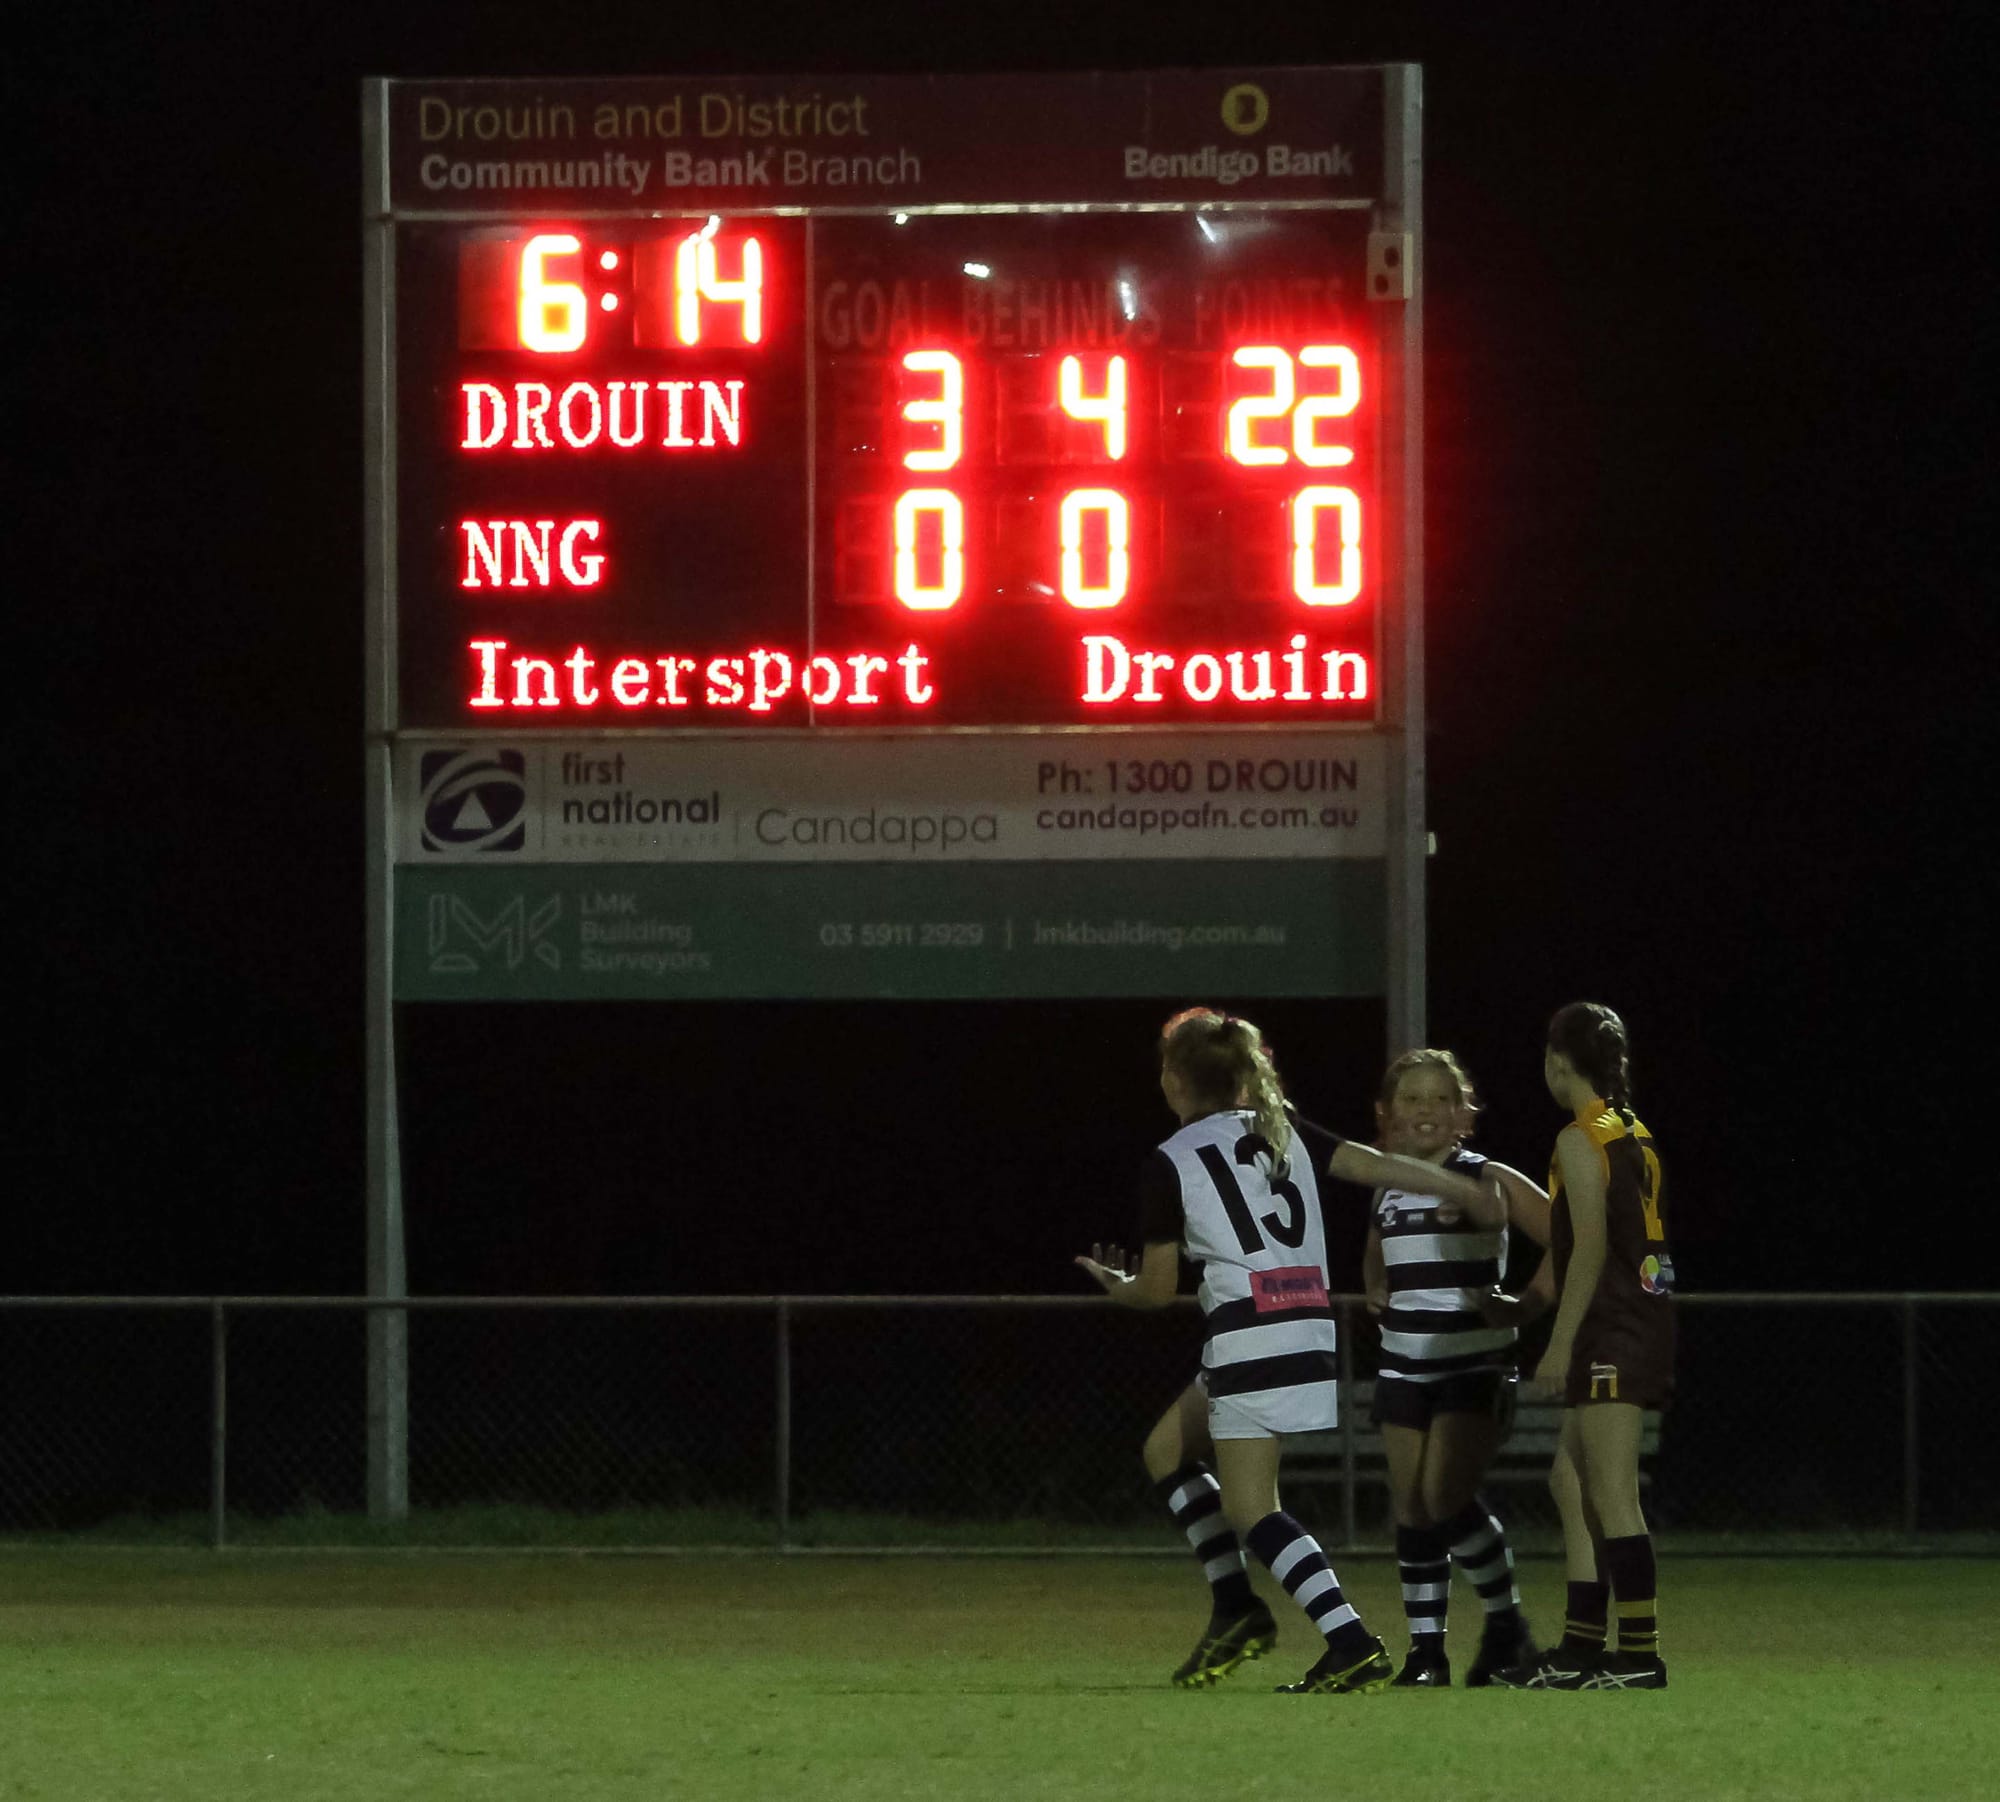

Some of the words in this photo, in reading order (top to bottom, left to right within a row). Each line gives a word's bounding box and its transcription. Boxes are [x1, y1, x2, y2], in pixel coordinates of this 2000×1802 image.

[419, 97, 575, 142] Drouin
[593, 95, 683, 138] and
[700, 93, 869, 138] District
[420, 154, 650, 195] Community
[782, 147, 921, 186] Branch
[1124, 145, 1259, 185] Bendigo
[1267, 144, 1353, 176] Bank
[461, 380, 745, 450] DROUIN
[902, 350, 962, 471] 3
[1060, 355, 1127, 461] 4
[1228, 346, 1361, 468] 22
[461, 520, 604, 589] NNG
[895, 489, 964, 610] 0
[1060, 489, 1129, 609] 0
[1294, 486, 1361, 606] 0
[469, 641, 933, 712] Intersport
[1082, 634, 1370, 704] Drouin
[563, 753, 625, 785] first
[1037, 762, 1090, 793] Ph:
[1107, 761, 1193, 793] 1300
[1207, 760, 1357, 792] DROUIN
[563, 792, 720, 824] national
[1036, 804, 1358, 834] candappafn.com.au
[756, 809, 997, 851] Candappa
[580, 891, 638, 915] LMK
[580, 920, 693, 946] Building
[818, 923, 854, 946] 03
[919, 923, 985, 946] 2929
[580, 948, 713, 975] Surveyors
[1196, 1133, 1307, 1255] 13
